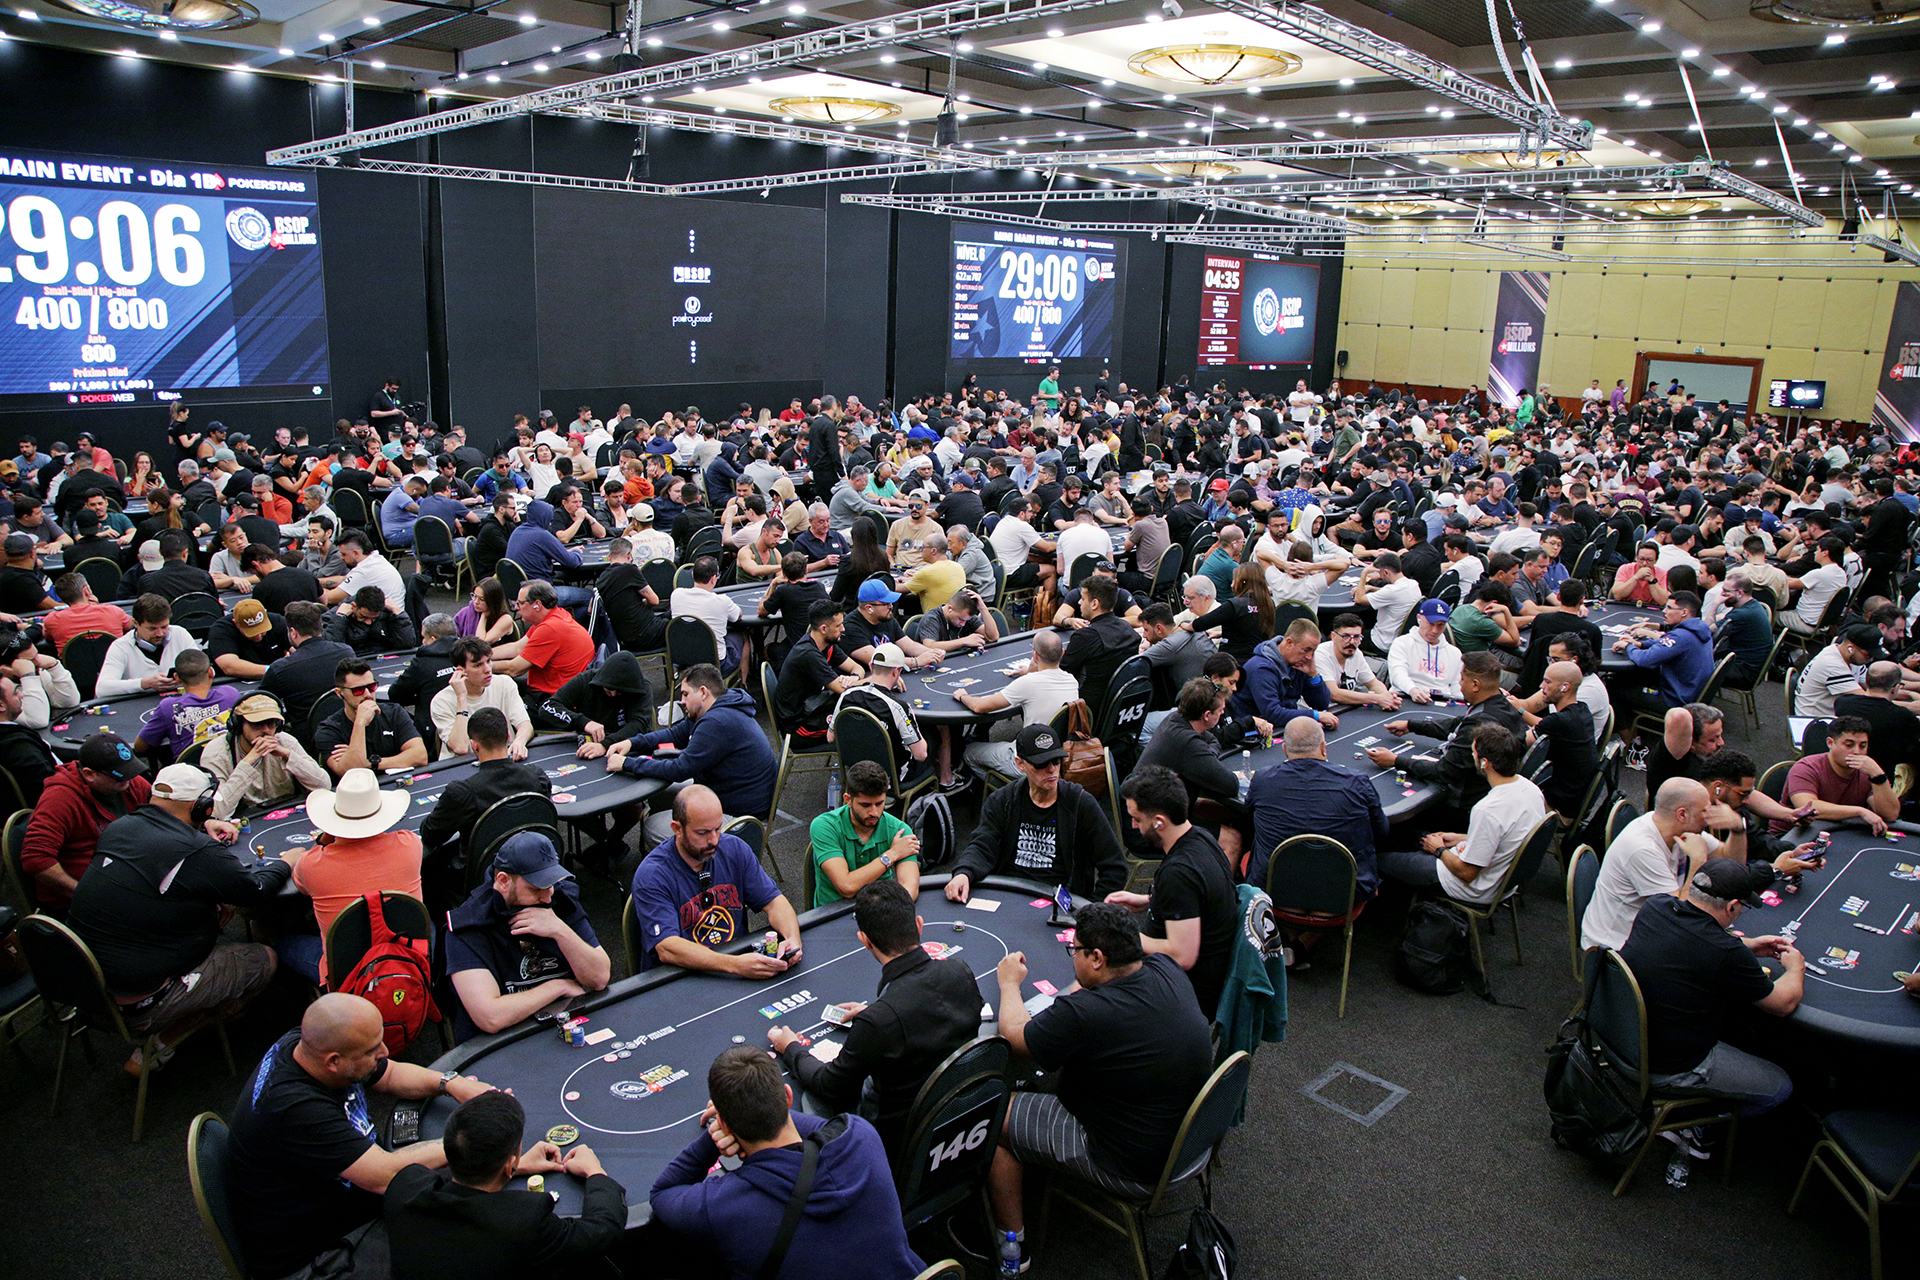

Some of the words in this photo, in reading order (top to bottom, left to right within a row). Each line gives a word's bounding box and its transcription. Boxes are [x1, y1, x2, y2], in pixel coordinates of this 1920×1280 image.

[61, 162, 134, 184] EVENT
[150, 169, 187, 188] Dia
[228, 177, 306, 192] POKERSTARS
[274, 216, 309, 233] BSOP
[0, 195, 206, 287] 9:06
[1014, 233, 1035, 244] MAIN
[1036, 235, 1059, 246] EVENT
[1207, 258, 1240, 269] INTERVALO
[999, 251, 1078, 301] 29:06
[1205, 269, 1240, 290] 04:35
[16, 297, 82, 330] 400
[107, 297, 168, 330] 800
[1013, 306, 1034, 324] 400
[1041, 307, 1062, 325] 800
[87, 334, 107, 344] Ante
[1504, 326, 1532, 341] BSOP
[81, 344, 117, 363] 800
[1507, 341, 1537, 352] MILLIONS
[1899, 346, 1920, 365] BS
[73, 367, 107, 377] Próximo
[107, 366, 129, 377] Blind
[80, 393, 135, 402] POKERWEB
[179, 703, 220, 726] LAKERS
[1118, 702, 1146, 725] 143
[1042, 826, 1057, 834] LIFE
[680, 884, 743, 930] DEVER
[772, 989, 812, 1012] BSOP
[640, 1065, 673, 1084] BSOP
[655, 1069, 690, 1088] MILLIONS
[929, 1118, 990, 1172] 146
